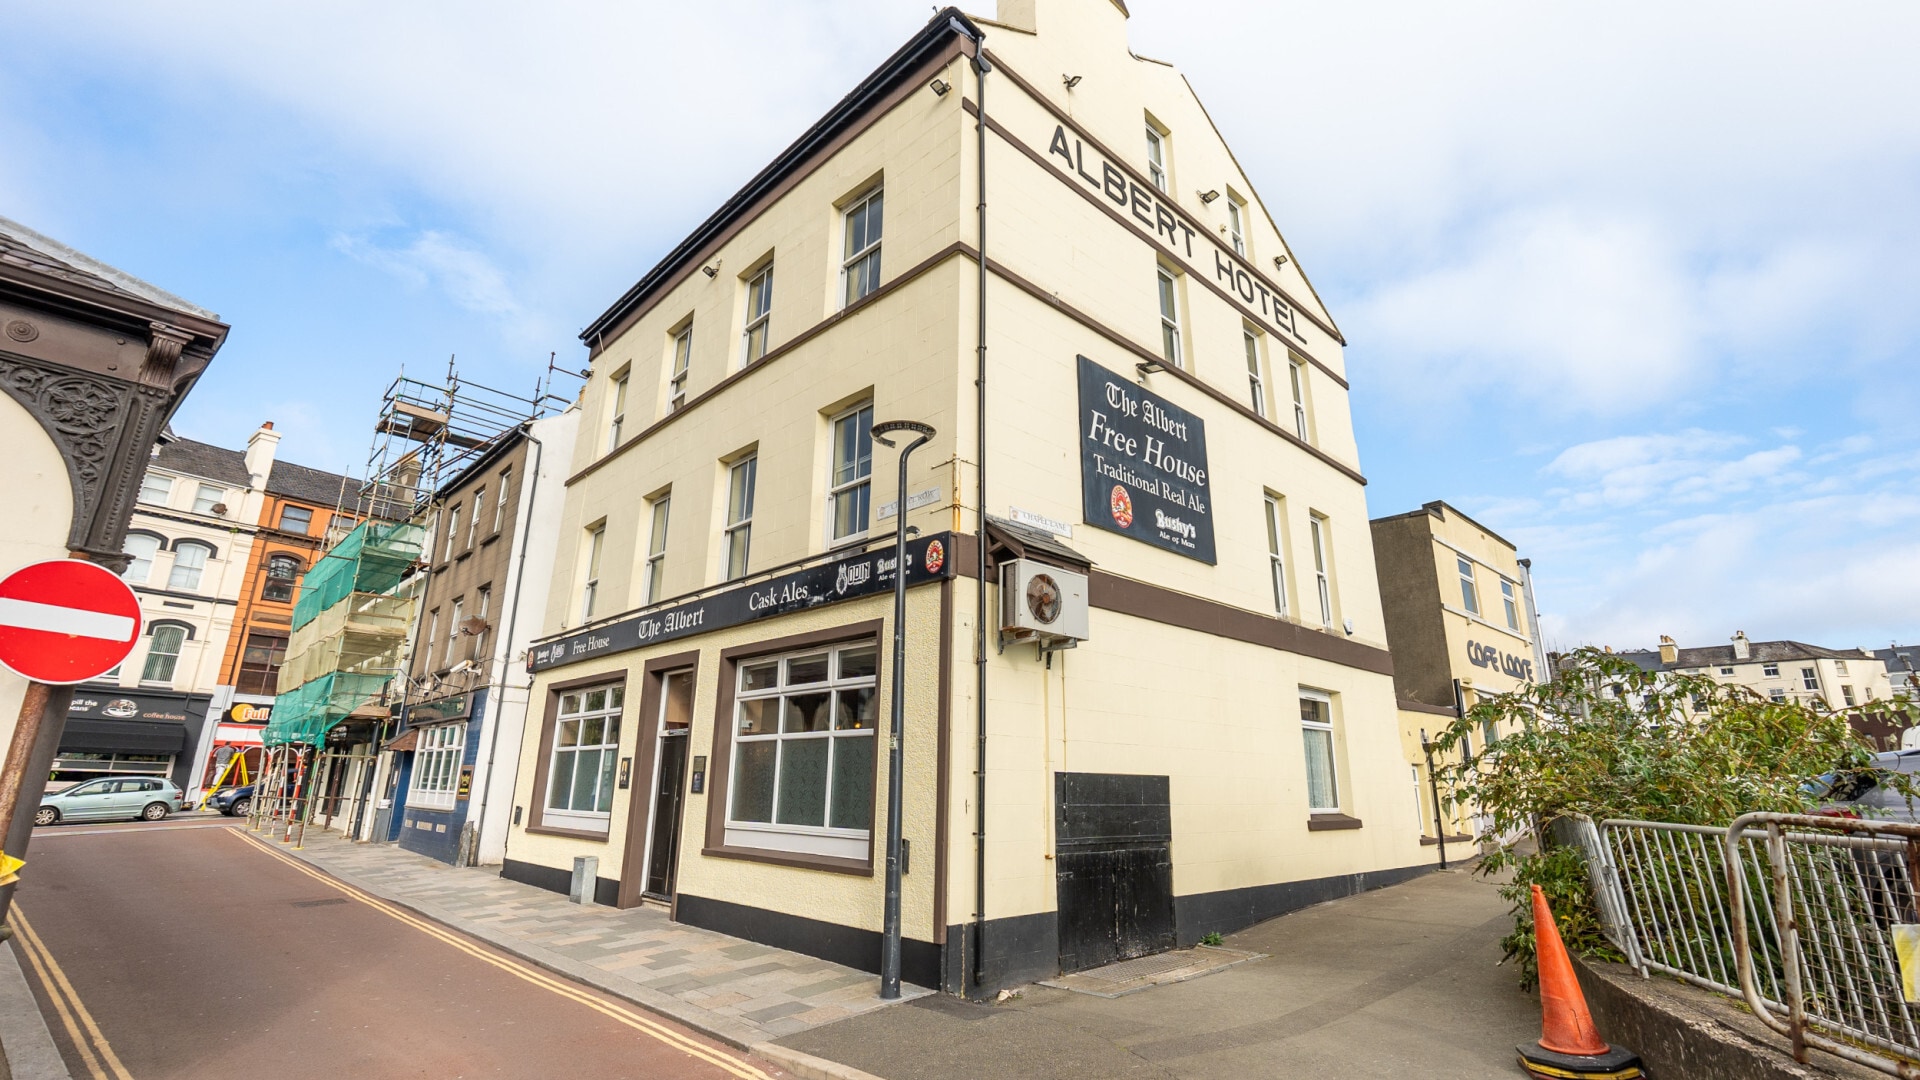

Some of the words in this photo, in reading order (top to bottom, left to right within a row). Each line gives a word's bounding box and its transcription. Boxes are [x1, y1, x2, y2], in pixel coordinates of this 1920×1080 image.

[1048, 124, 1196, 258] ALBERT
[1214, 249, 1308, 345] HOTEL
[1105, 381, 1138, 417] The
[1142, 400, 1188, 442] Albert
[1088, 409, 1137, 456] Free
[1143, 434, 1206, 486] House
[1093, 453, 1160, 496] Traditional
[1161, 481, 1186, 507] Real
[1188, 493, 1205, 514] Ale
[1155, 508, 1196, 539] Bushy's
[1159, 530, 1171, 540] Ale
[1181, 538, 1195, 549] Man
[847, 561, 871, 585] ODIN
[749, 587, 777, 611] Cask
[780, 581, 808, 604] Ales
[638, 619, 661, 641] The
[663, 606, 705, 634] Albert
[572, 640, 587, 655] Free
[587, 635, 610, 651] House
[70, 698, 84, 706] pill
[165, 712, 186, 720] house
[243, 707, 270, 720] Full
